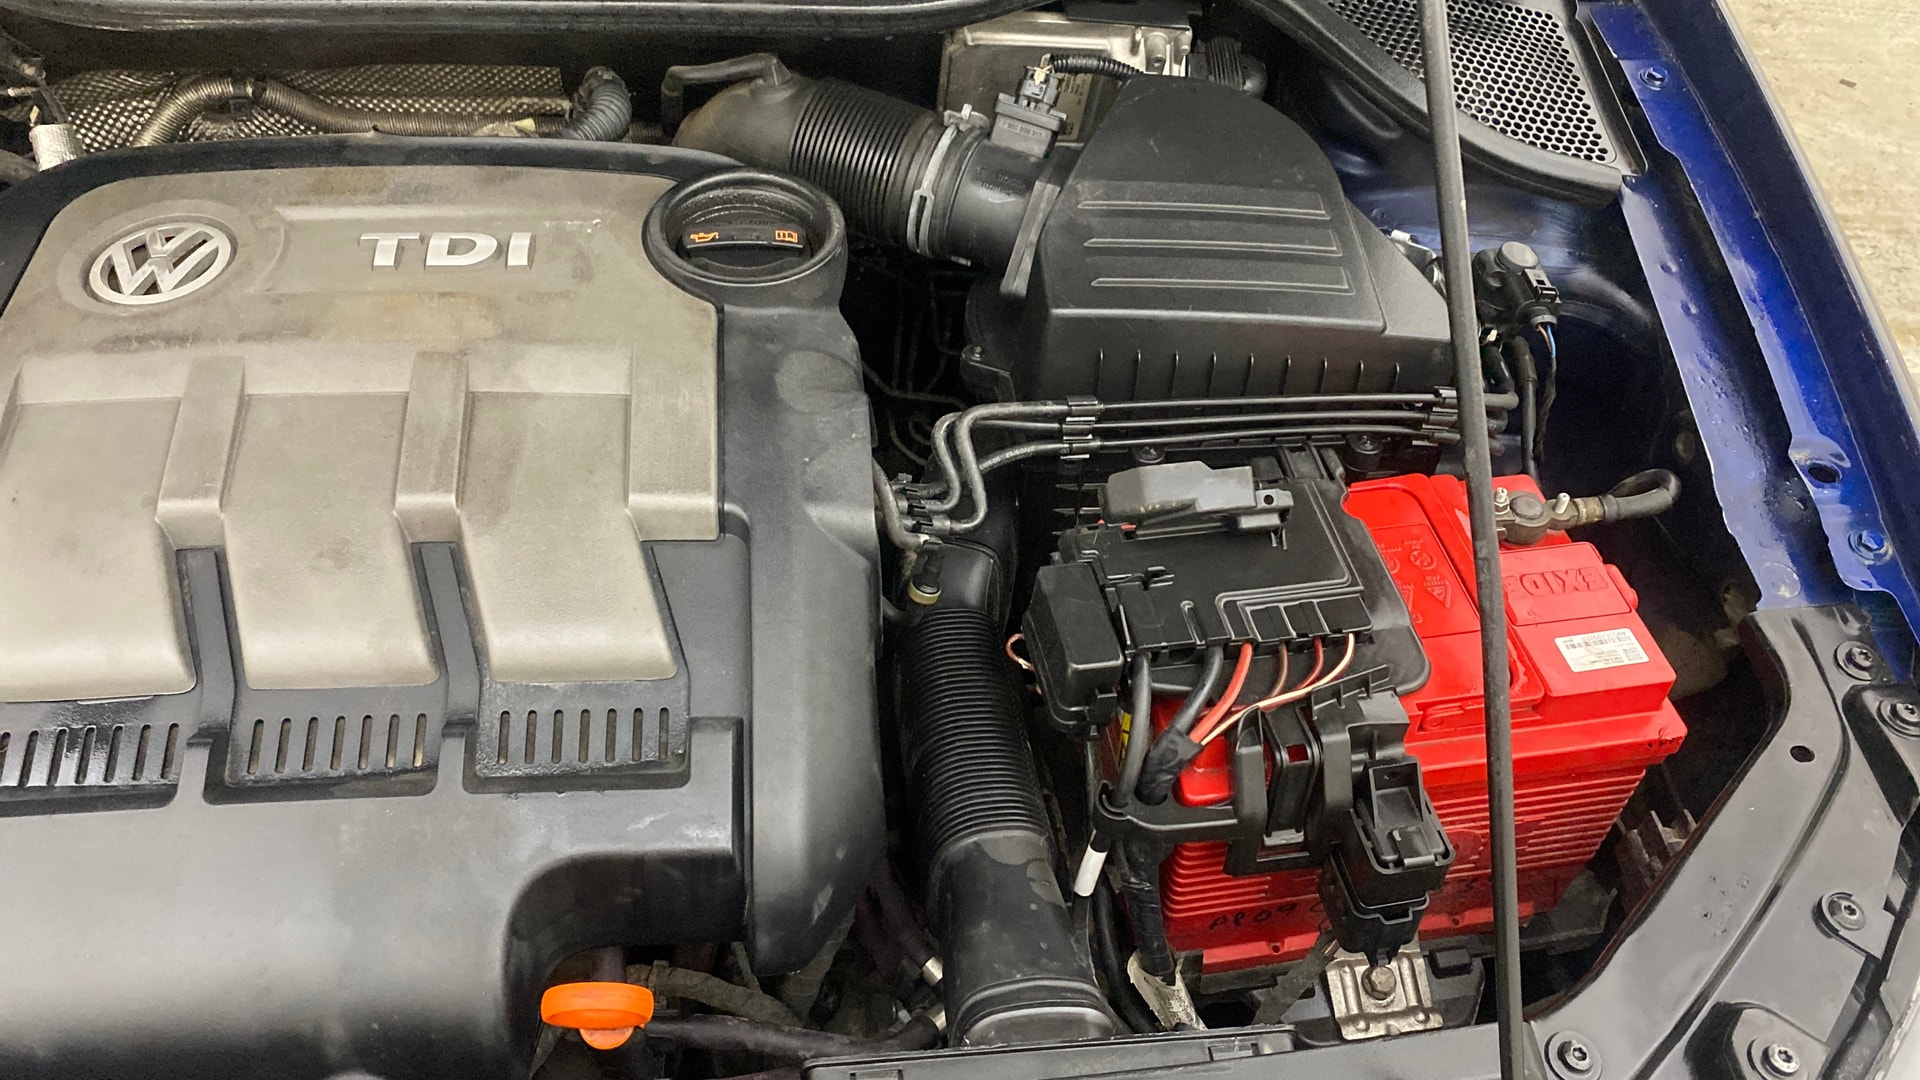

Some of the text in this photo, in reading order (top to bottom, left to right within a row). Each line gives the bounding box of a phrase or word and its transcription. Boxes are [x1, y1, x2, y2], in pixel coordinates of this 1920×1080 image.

[88, 221, 232, 305] VW
[360, 231, 533, 270] TDI
[1502, 567, 1608, 596] EXIDE
